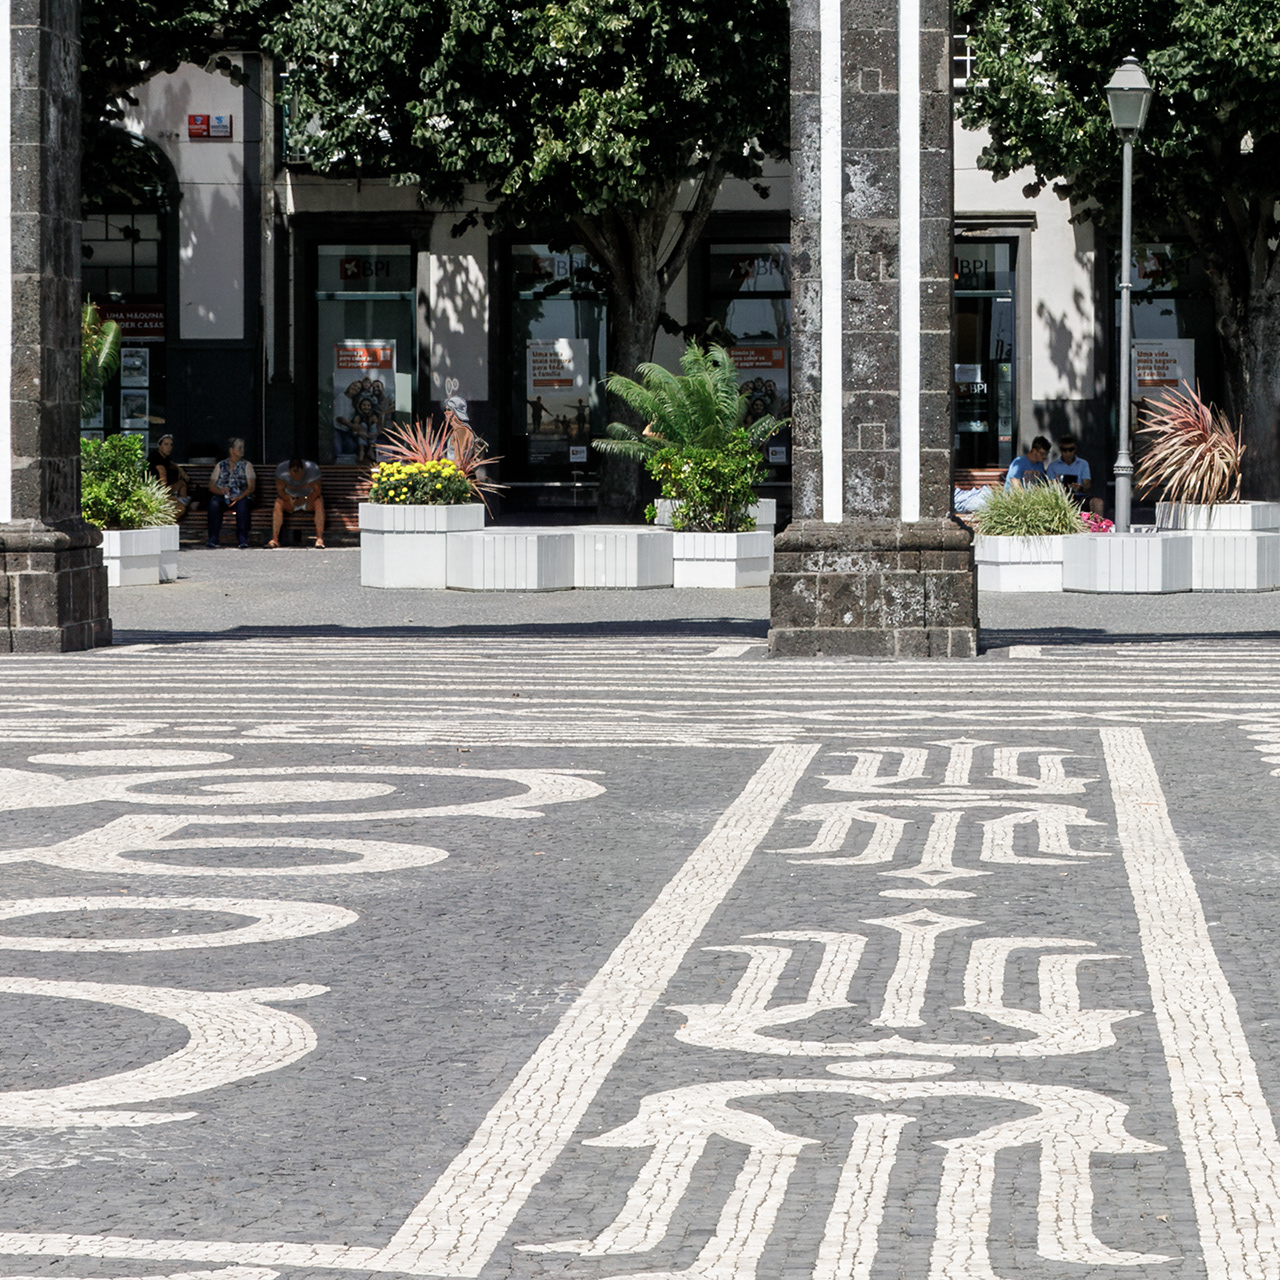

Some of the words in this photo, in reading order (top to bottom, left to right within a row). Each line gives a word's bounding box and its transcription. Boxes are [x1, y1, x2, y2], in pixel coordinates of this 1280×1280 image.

[362, 261, 389, 277] BPI
[960, 260, 988, 275] BPI
[970, 383, 988, 394] BPI
